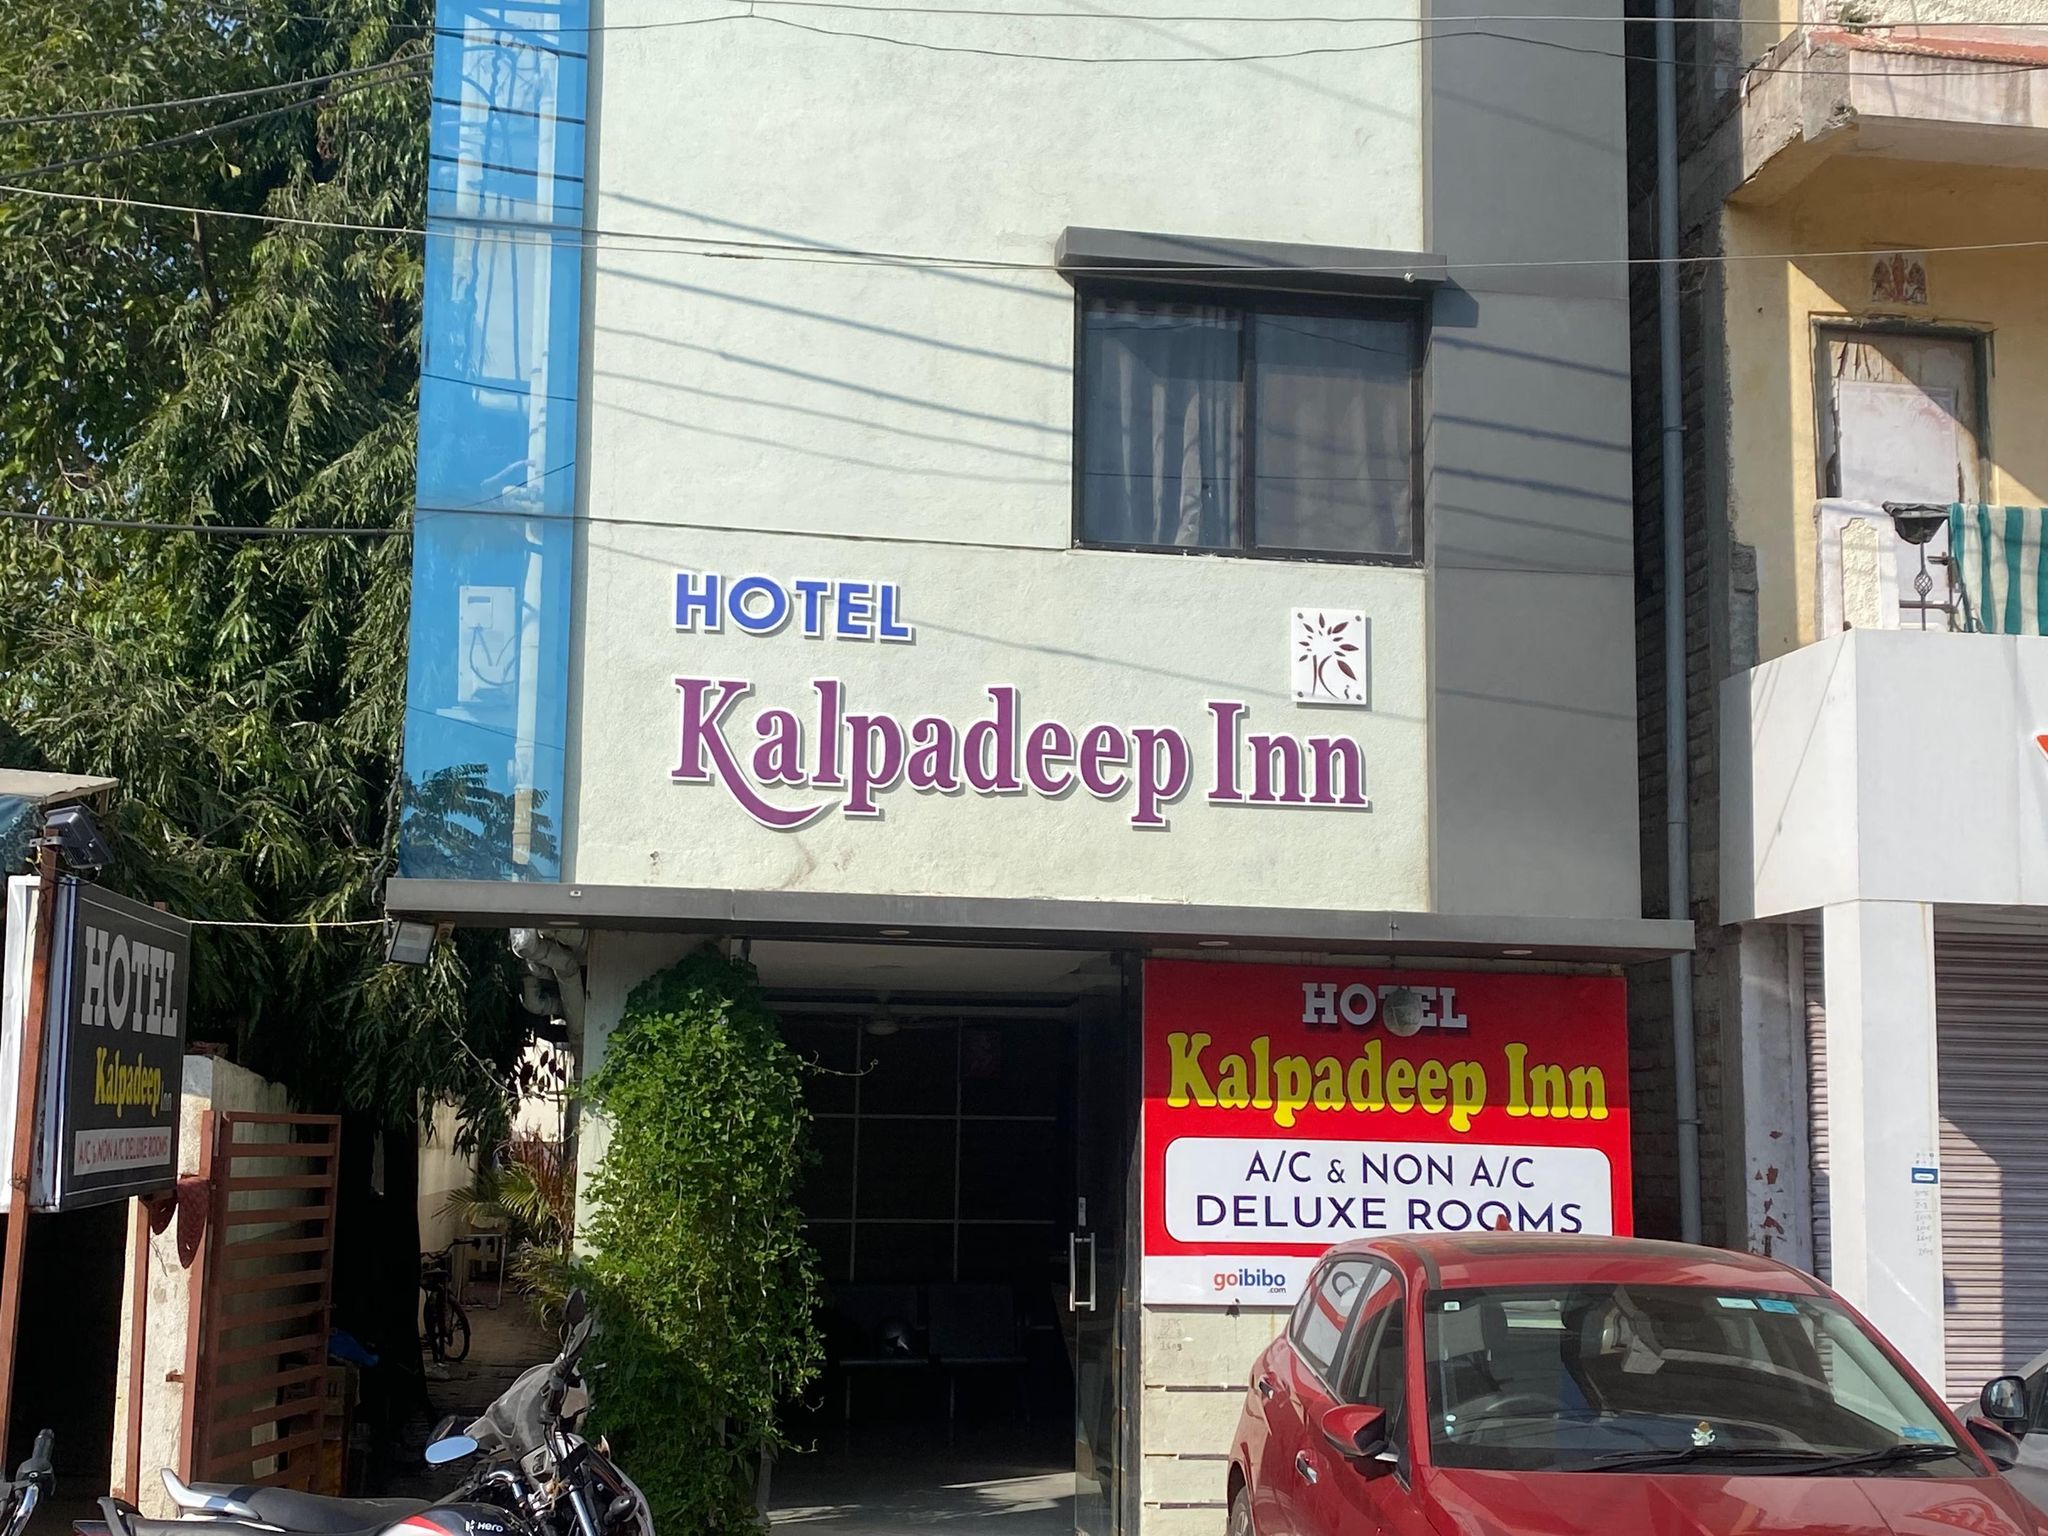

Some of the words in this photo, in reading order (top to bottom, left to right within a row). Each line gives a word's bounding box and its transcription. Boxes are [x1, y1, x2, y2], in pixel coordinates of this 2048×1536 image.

[675, 571, 915, 643] HOTEL
[671, 677, 1192, 829] Kalpadeep
[1206, 699, 1370, 809] Inn
[81, 926, 177, 1037] HOTEL
[95, 1046, 161, 1118] Kalpadeep
[1166, 1031, 1487, 1132] Kalpadeep
[1504, 1041, 1609, 1120] Inn
[1245, 1150, 1312, 1184] A/C
[1327, 1157, 1346, 1184] &
[1362, 1152, 1454, 1187] NON
[1470, 1156, 1535, 1189] A/C
[1196, 1194, 1387, 1230] DELUXE
[1407, 1198, 1583, 1234] ROOMS
[1214, 1268, 1286, 1291] goibibo
[1268, 1286, 1287, 1294] .com
